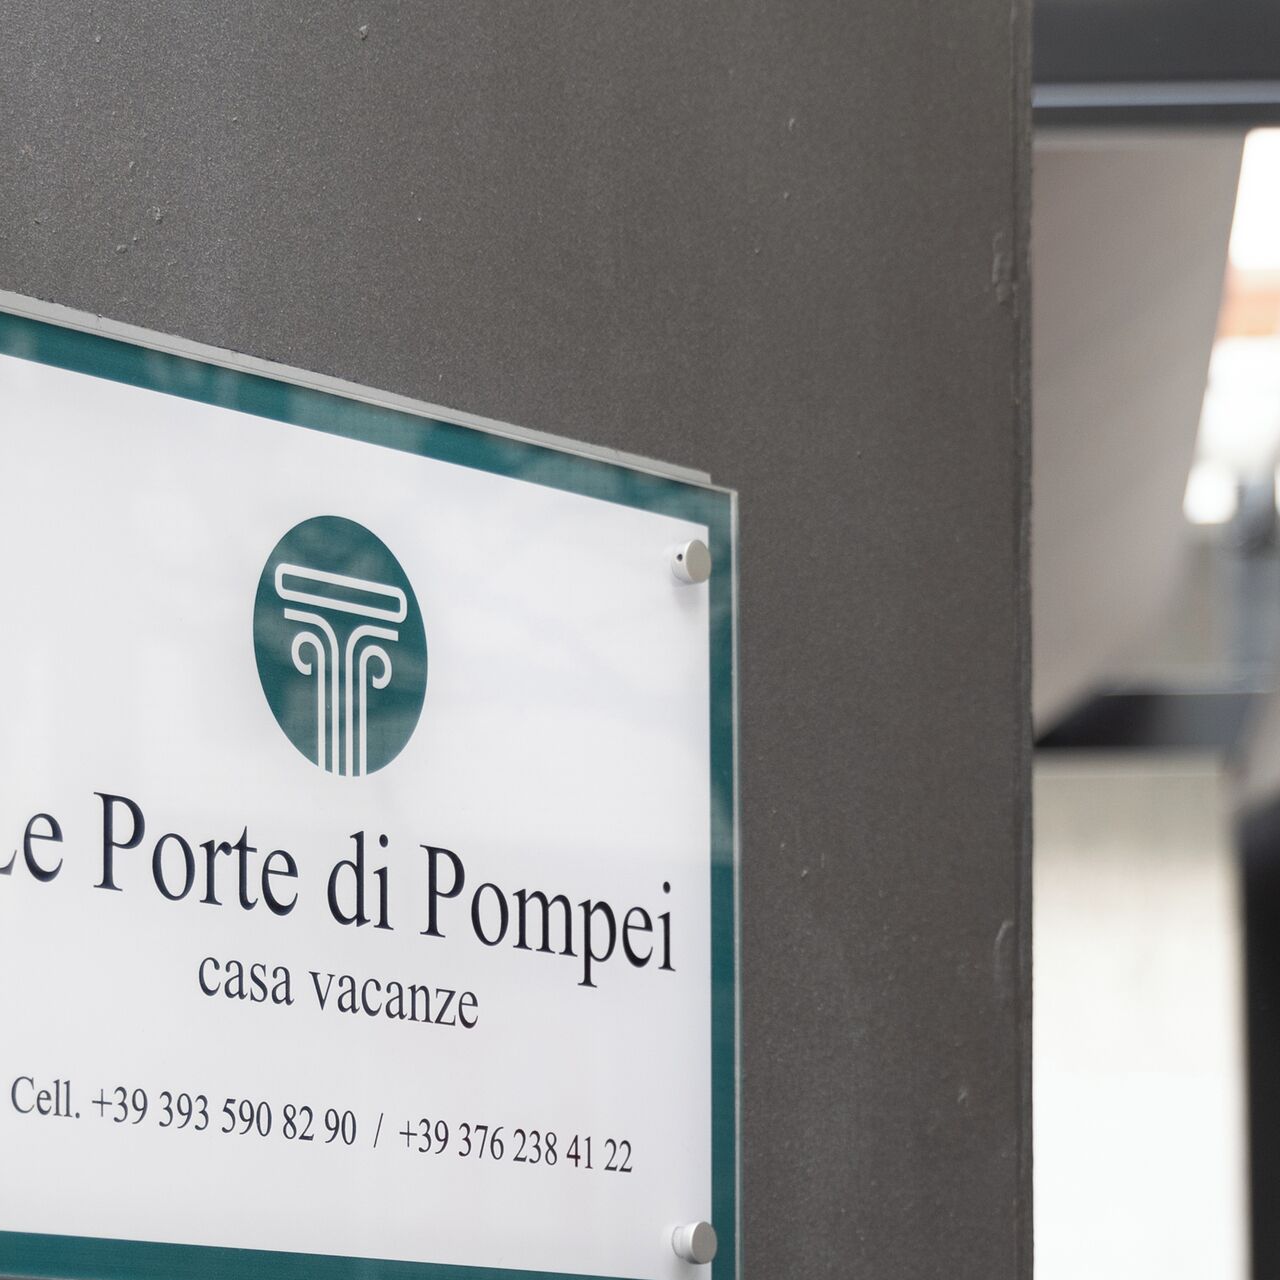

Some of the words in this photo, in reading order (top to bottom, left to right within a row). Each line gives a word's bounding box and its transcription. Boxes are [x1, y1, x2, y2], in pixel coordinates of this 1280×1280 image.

[93, 791, 299, 917] Porte
[327, 830, 394, 931] di
[419, 844, 676, 989] Pompei
[198, 956, 295, 1006] casa
[308, 970, 479, 1029] vacanze
[11, 1076, 81, 1120] Cell.
[91, 1086, 148, 1125] +39
[158, 1090, 209, 1131] 393
[221, 1098, 272, 1137] 590
[282, 1103, 315, 1141] 82
[324, 1108, 357, 1146] 90
[372, 1112, 384, 1149] /
[399, 1118, 449, 1155] +39
[458, 1122, 505, 1161] 376
[512, 1128, 558, 1166] 238
[566, 1134, 594, 1170] 41
[604, 1138, 633, 1173] 22
